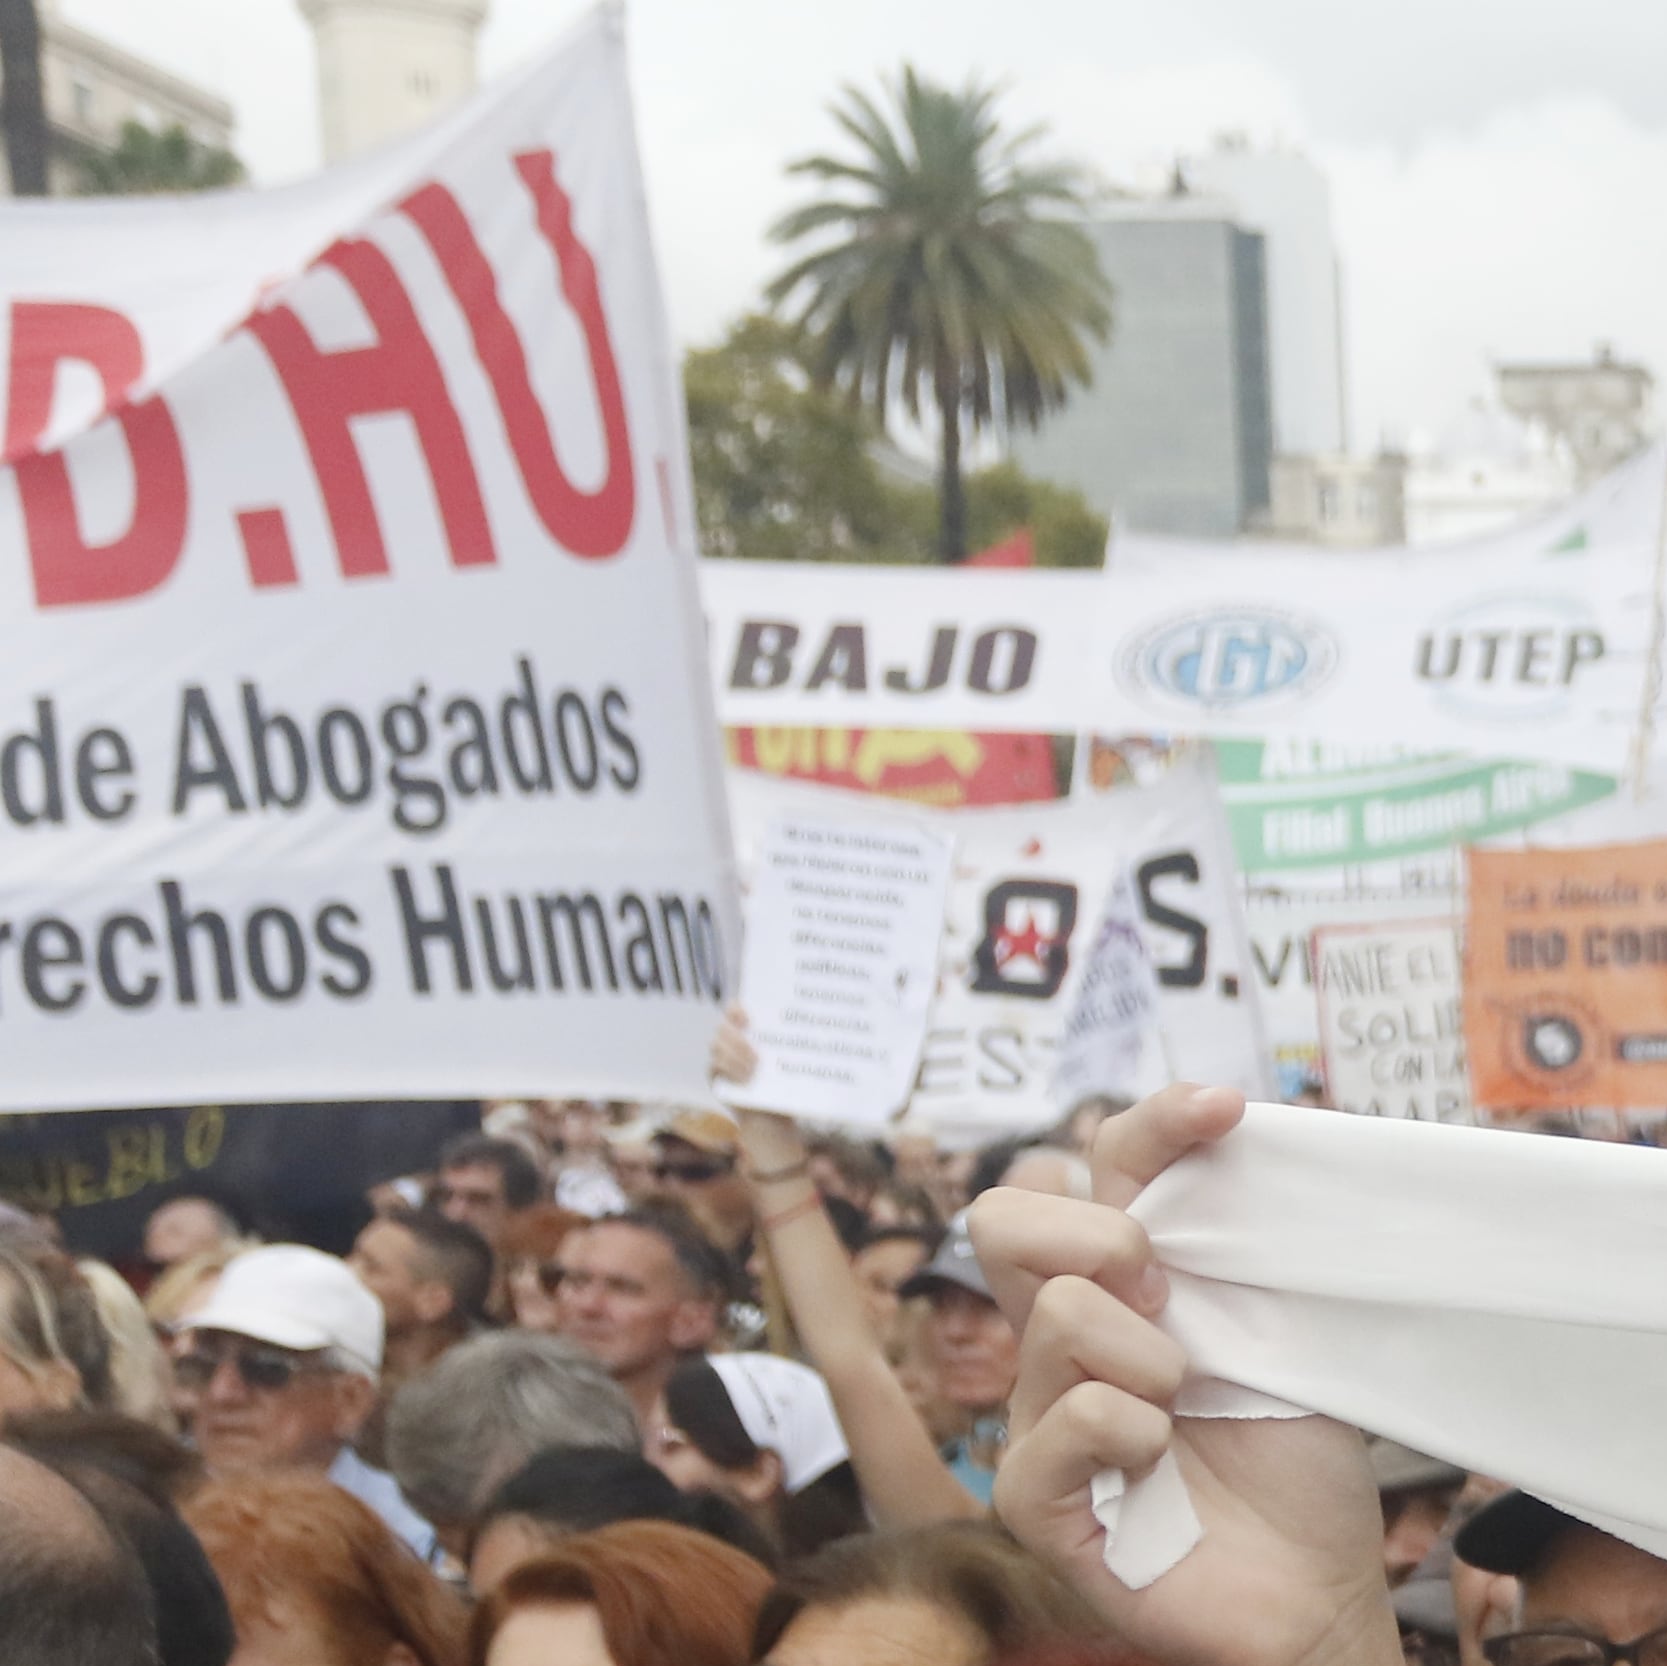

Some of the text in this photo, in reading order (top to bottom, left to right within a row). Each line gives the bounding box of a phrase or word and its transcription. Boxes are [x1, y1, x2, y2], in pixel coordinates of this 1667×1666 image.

[728, 618, 1039, 697] BAJO
[1414, 624, 1604, 689] UTEP
[0, 697, 136, 829] de
[170, 652, 645, 836] Abogados
[1505, 926, 1569, 972] no
